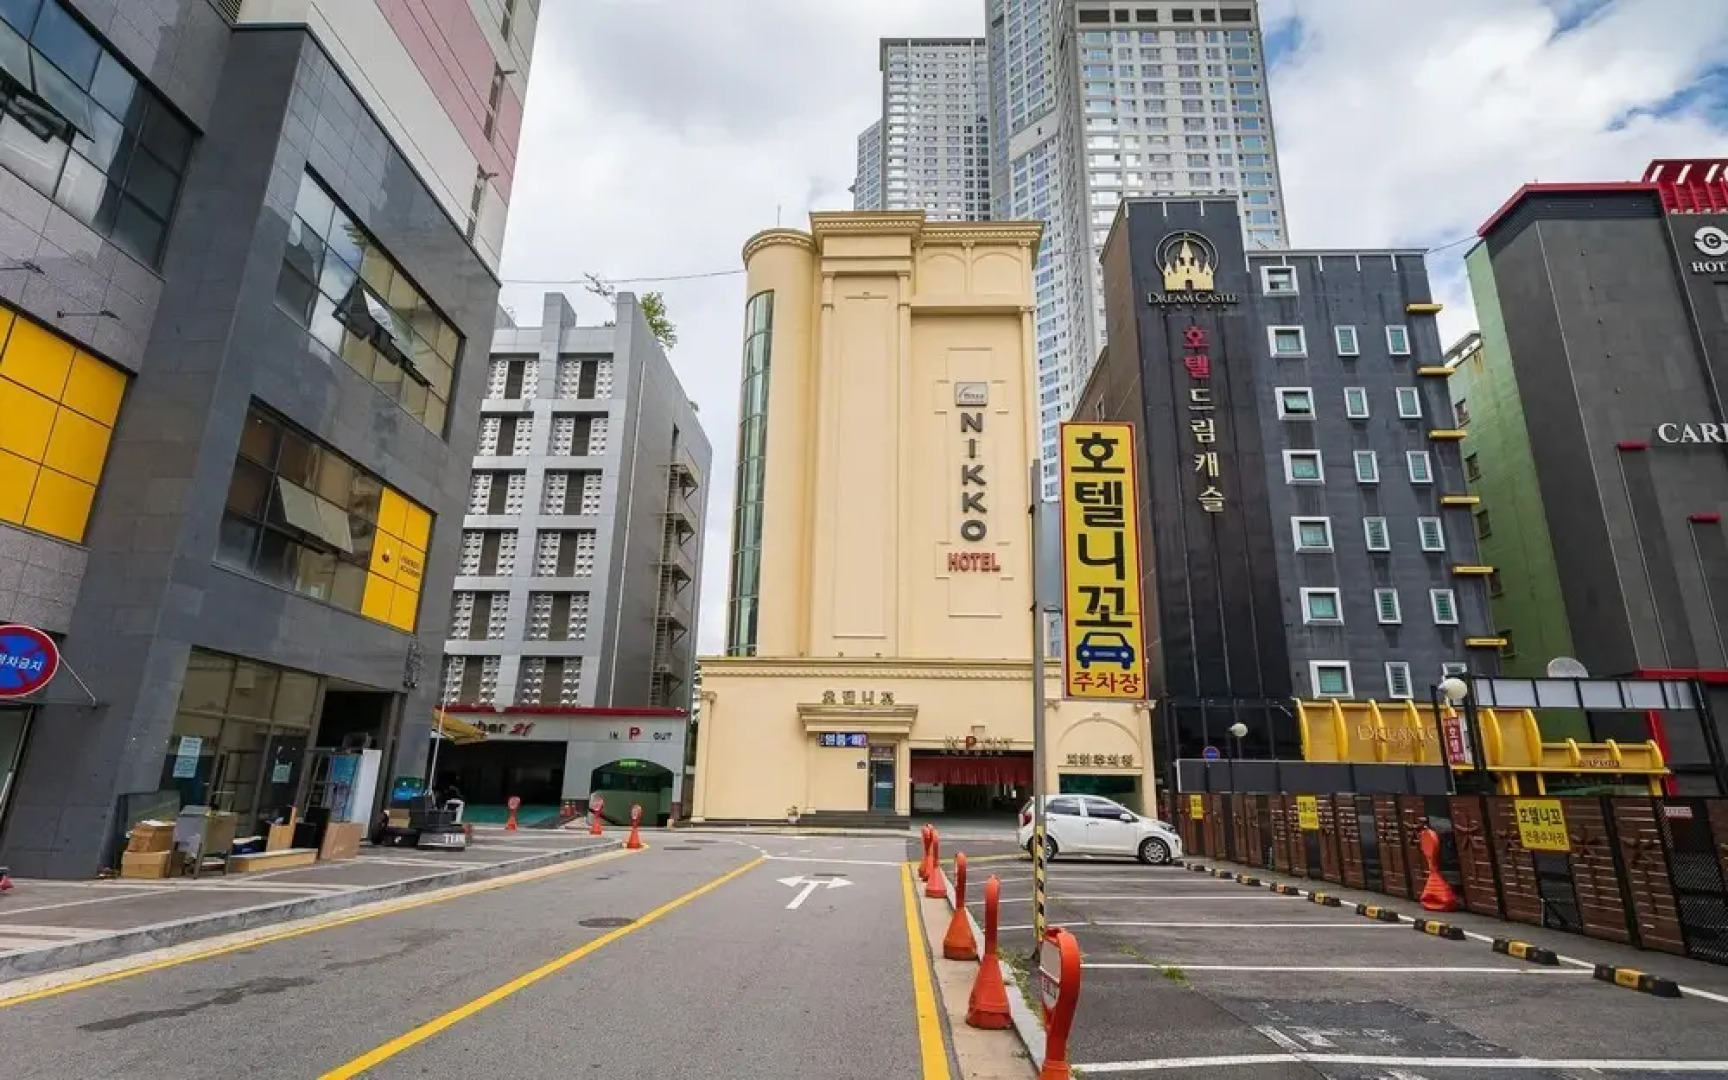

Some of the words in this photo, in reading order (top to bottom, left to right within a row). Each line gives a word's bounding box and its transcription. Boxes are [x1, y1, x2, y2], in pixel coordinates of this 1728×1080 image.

[1147, 292, 1193, 304] DREAM
[1195, 292, 1240, 304] CASTLE
[1182, 325, 1211, 379] 호텔
[1188, 387, 1226, 513] 드림캐슬
[959, 411, 988, 543] NIKKO
[1070, 431, 1133, 628] 호텔니꼬
[948, 552, 1002, 573] HOTEL
[1073, 671, 1141, 693] 주차장
[628, 727, 641, 740] P
[652, 732, 673, 741] OUT
[965, 735, 977, 750] P
[1518, 806, 1564, 826] 호텔니꼬
